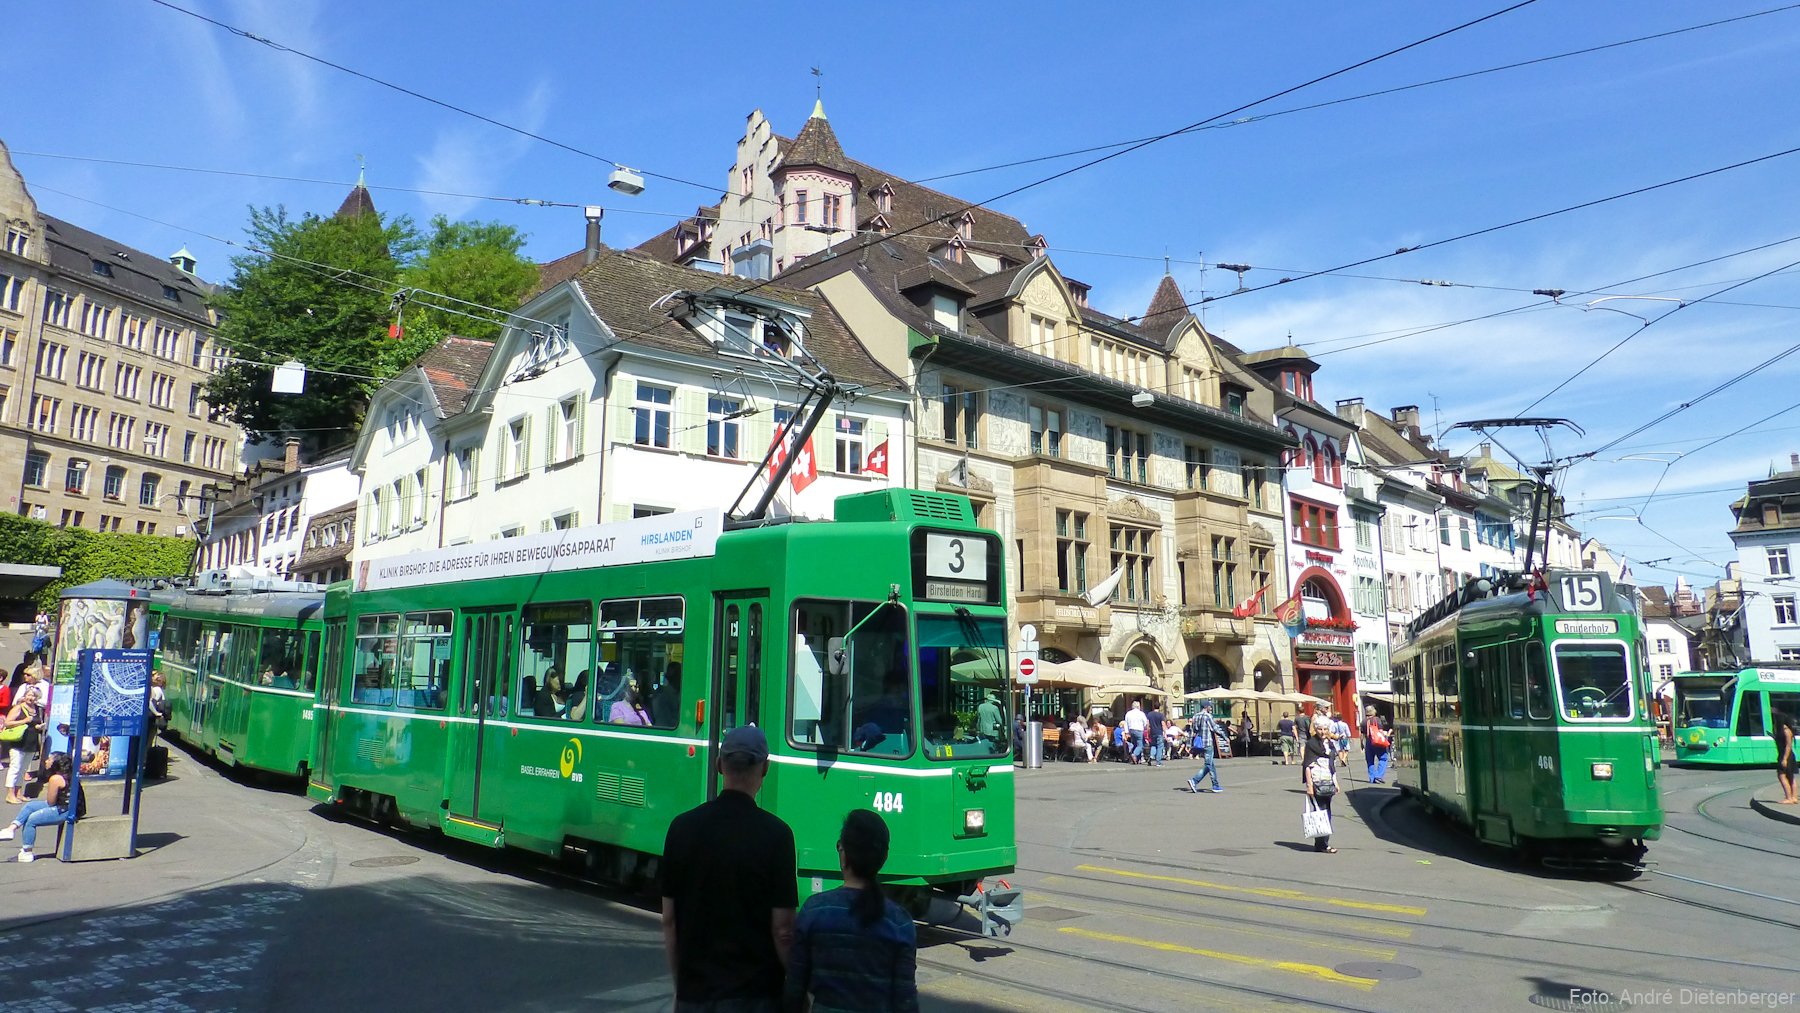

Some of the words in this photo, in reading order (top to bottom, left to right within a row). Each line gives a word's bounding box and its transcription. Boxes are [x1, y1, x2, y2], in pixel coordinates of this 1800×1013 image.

[641, 529, 693, 546] HIRSLANDEN
[379, 565, 399, 579] KLINIK
[399, 562, 428, 577] BIRSHOF:
[429, 560, 440, 573] DIE
[441, 556, 472, 572] ADRESSE
[474, 551, 489, 567] FÜR
[490, 550, 515, 566] IHREN
[516, 536, 616, 563] BEWEGUNGSAPPARAT
[655, 547, 670, 556] KLINIK
[670, 544, 692, 554] BIRSHOF
[948, 538, 965, 574] 3
[930, 584, 964, 597] Birsfelden
[1564, 577, 1598, 606] 15
[1563, 623, 1609, 633] Bruderholz
[1538, 755, 1553, 770] 460
[520, 764, 535, 776] BASEL
[535, 766, 560, 779] ERFAHREN
[571, 772, 583, 783] BVB
[872, 791, 904, 813] 484
